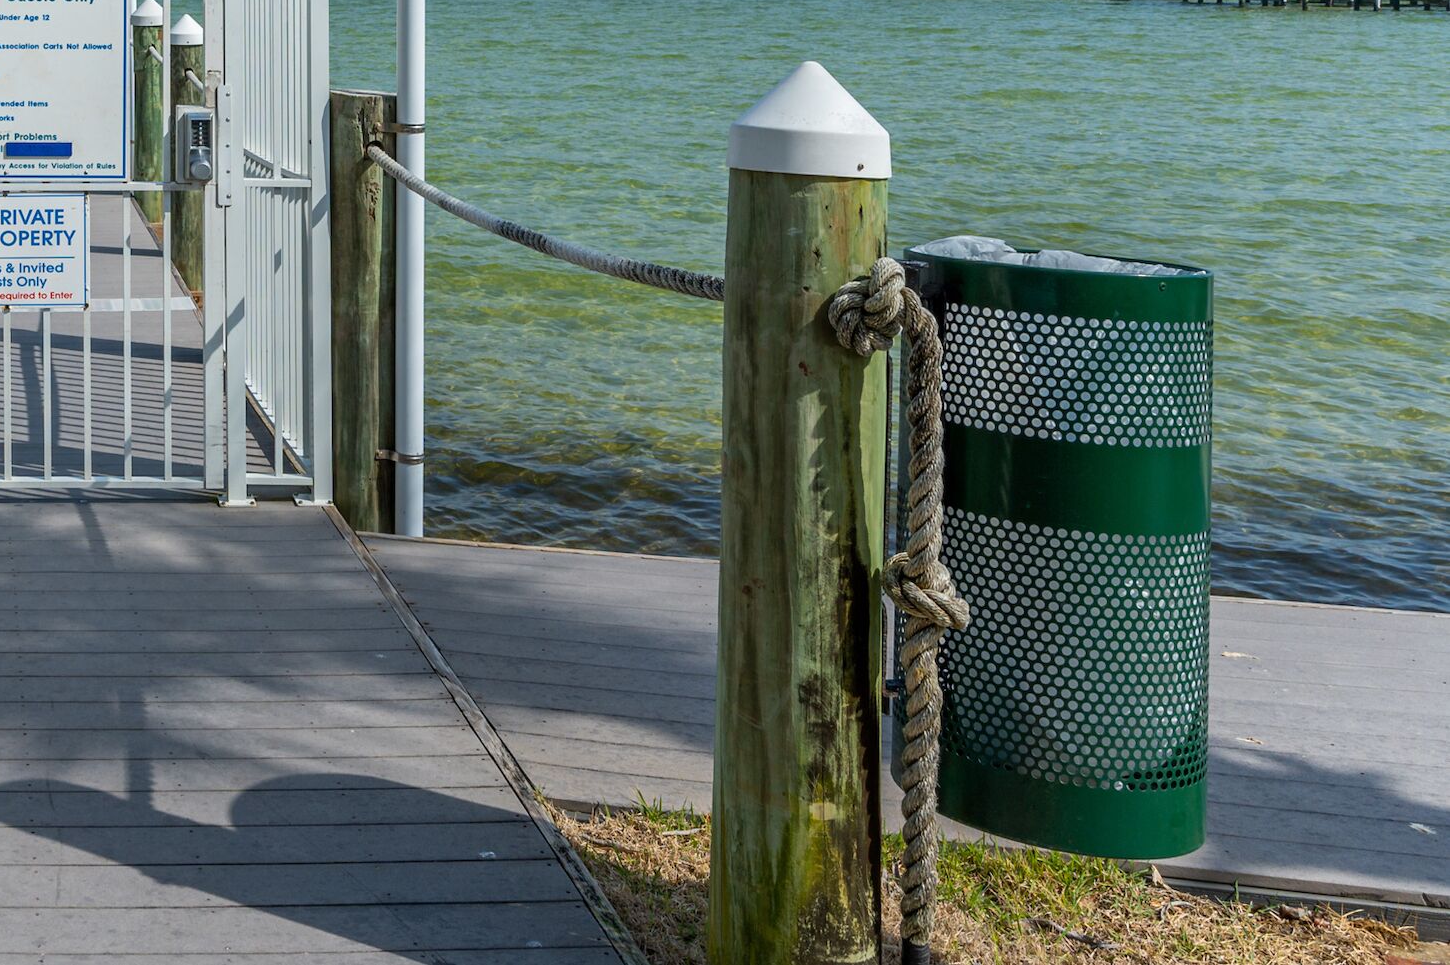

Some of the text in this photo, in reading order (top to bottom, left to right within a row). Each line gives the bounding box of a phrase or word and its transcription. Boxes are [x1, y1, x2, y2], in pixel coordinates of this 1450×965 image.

[14, 133, 57, 141] Problems
[6, 263, 14, 273] &
[19, 262, 64, 273] Invited
[16, 276, 47, 289] Only
